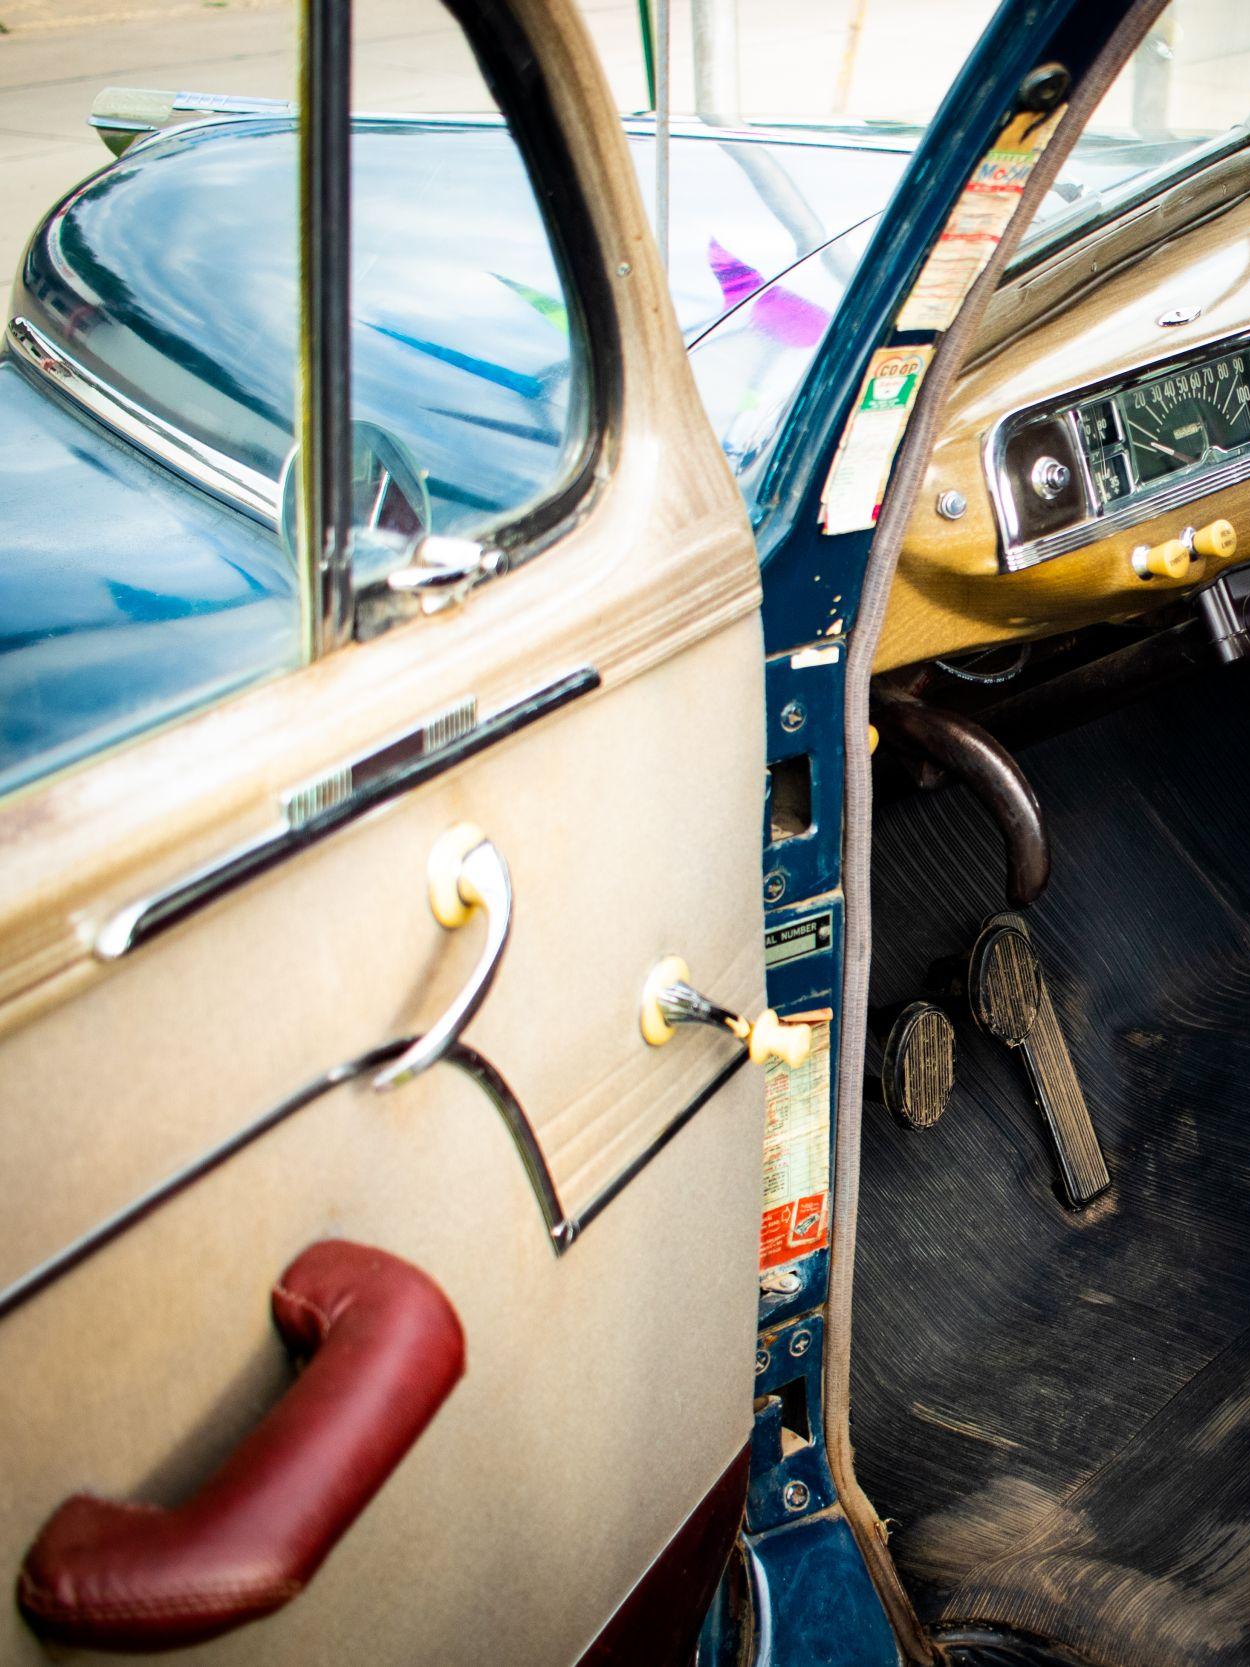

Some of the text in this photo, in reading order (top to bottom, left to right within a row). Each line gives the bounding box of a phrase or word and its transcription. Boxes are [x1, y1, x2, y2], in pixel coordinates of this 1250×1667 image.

[1133, 357, 1244, 409] 20 30 40 50 60 70 80 90
[1236, 385, 1250, 403] 100
[781, 922, 817, 941] NUMBER
